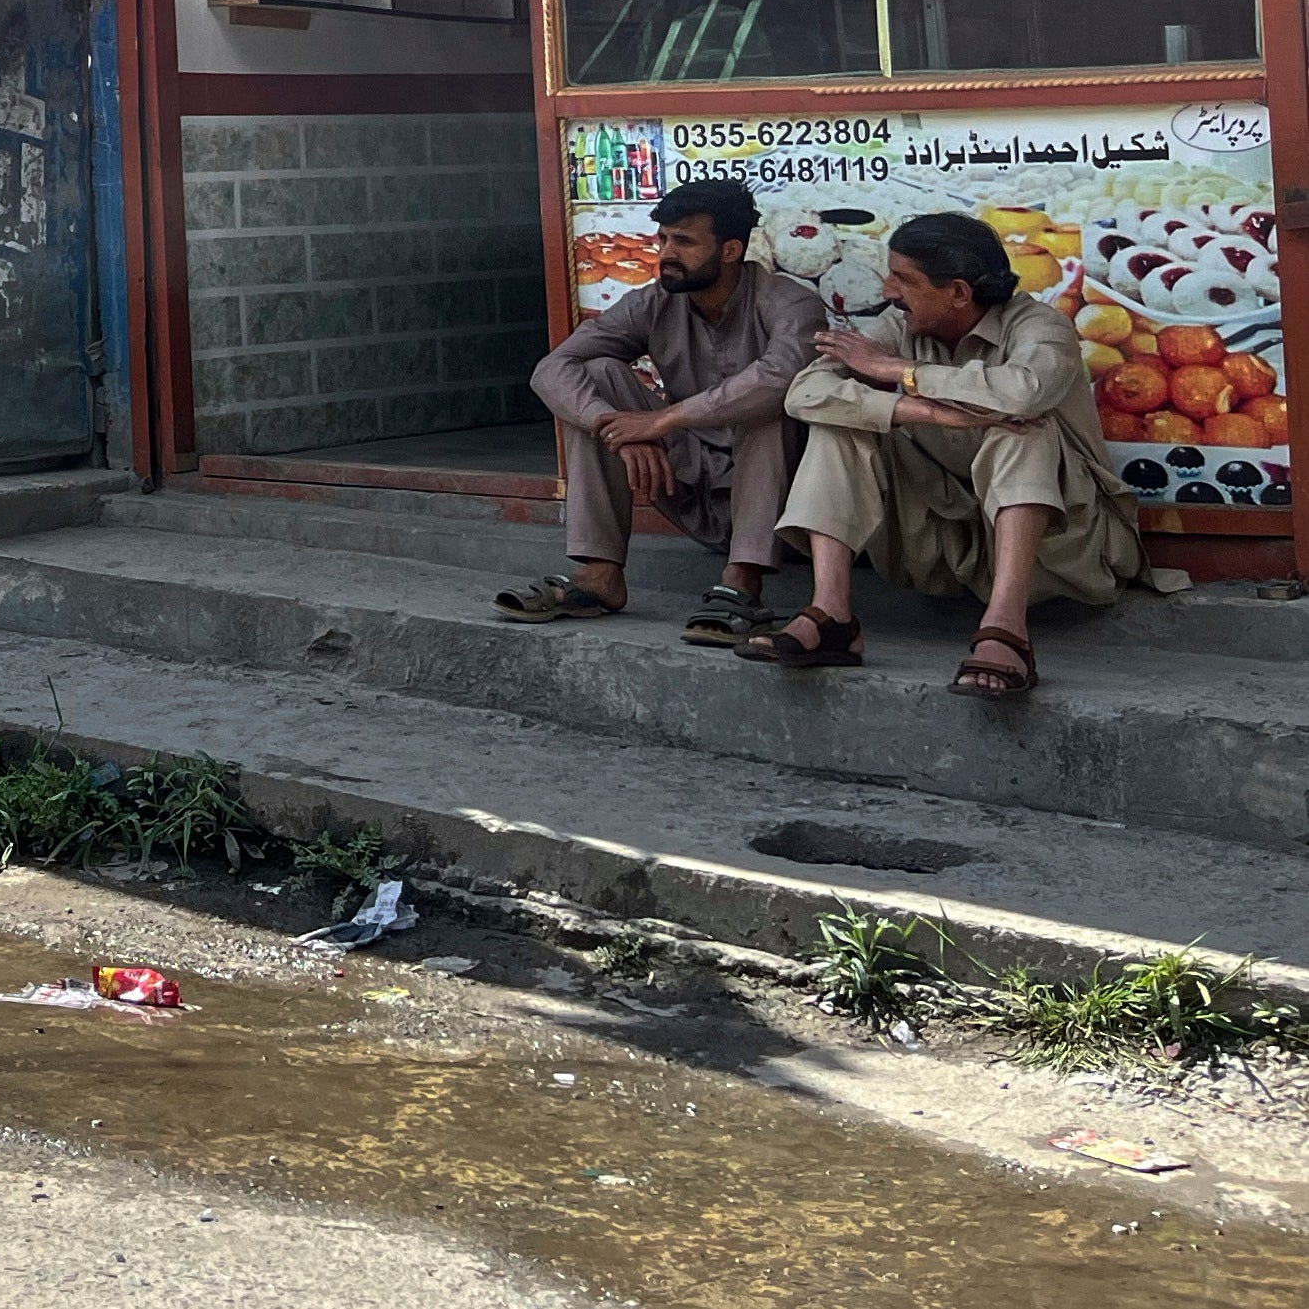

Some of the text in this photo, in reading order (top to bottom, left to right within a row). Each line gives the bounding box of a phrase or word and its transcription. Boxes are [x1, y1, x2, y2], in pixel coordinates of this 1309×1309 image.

[673, 118, 892, 149] 0355-6223804
[1022, 134, 1087, 164] احمد
[968, 130, 1019, 171] اینڈ
[1091, 130, 1170, 169] شکیل
[675, 157, 889, 184] 0355-6481119
